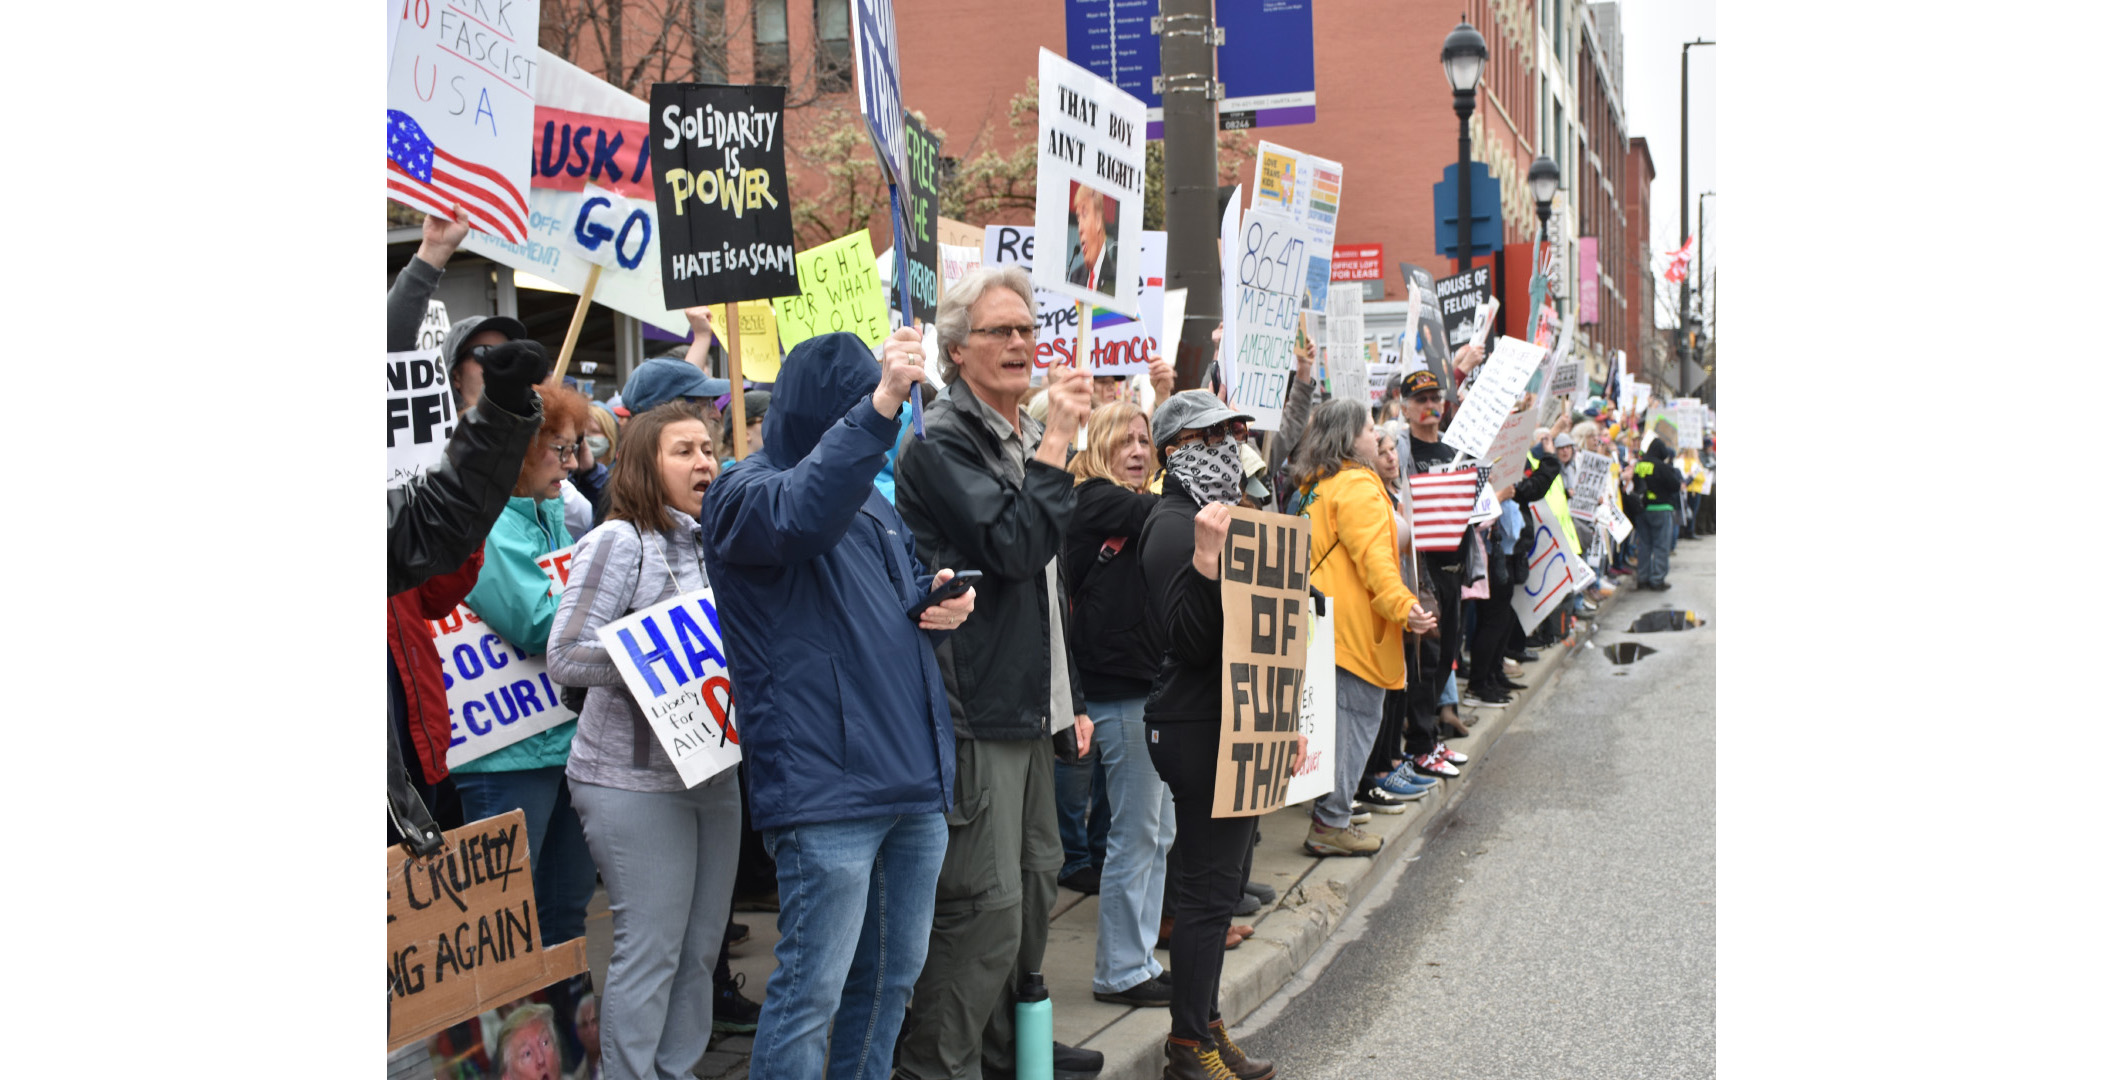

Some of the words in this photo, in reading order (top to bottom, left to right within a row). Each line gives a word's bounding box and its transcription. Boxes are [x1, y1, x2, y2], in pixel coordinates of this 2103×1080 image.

[440, 10, 537, 89] FASCIST
[1058, 83, 1098, 128] THAT
[1109, 110, 1134, 148] BOY
[531, 120, 625, 184] USK
[725, 147, 740, 177] IS
[905, 125, 937, 196] FREE
[665, 167, 779, 219] POWER
[1262, 177, 1275, 189] KIDS
[574, 196, 652, 271] GO
[910, 195, 931, 243] HE
[672, 250, 722, 281] HATE
[750, 243, 796, 277] SCAM
[799, 242, 860, 288] IGHT
[1332, 270, 1350, 279] FOR
[1352, 268, 1379, 279] LEASE
[1437, 273, 1472, 298] HOUSE
[1475, 268, 1487, 287] OF
[423, 305, 447, 330] HAT
[783, 292, 819, 322] FOR
[826, 267, 873, 306] WHAT
[1237, 286, 1300, 333] MPEACH
[1443, 290, 1483, 315] FELONS
[387, 354, 446, 391] NDS
[1033, 336, 1157, 370] esitance
[387, 391, 454, 448] FF!
[1224, 518, 1312, 592] GUL
[1250, 593, 1300, 656] OF
[448, 671, 560, 749] ECURI
[651, 690, 700, 720] Liberty
[669, 711, 694, 729] for
[1229, 662, 1304, 732] FUCK
[404, 823, 523, 913] CRUELTY
[435, 899, 534, 984] AGAIN
